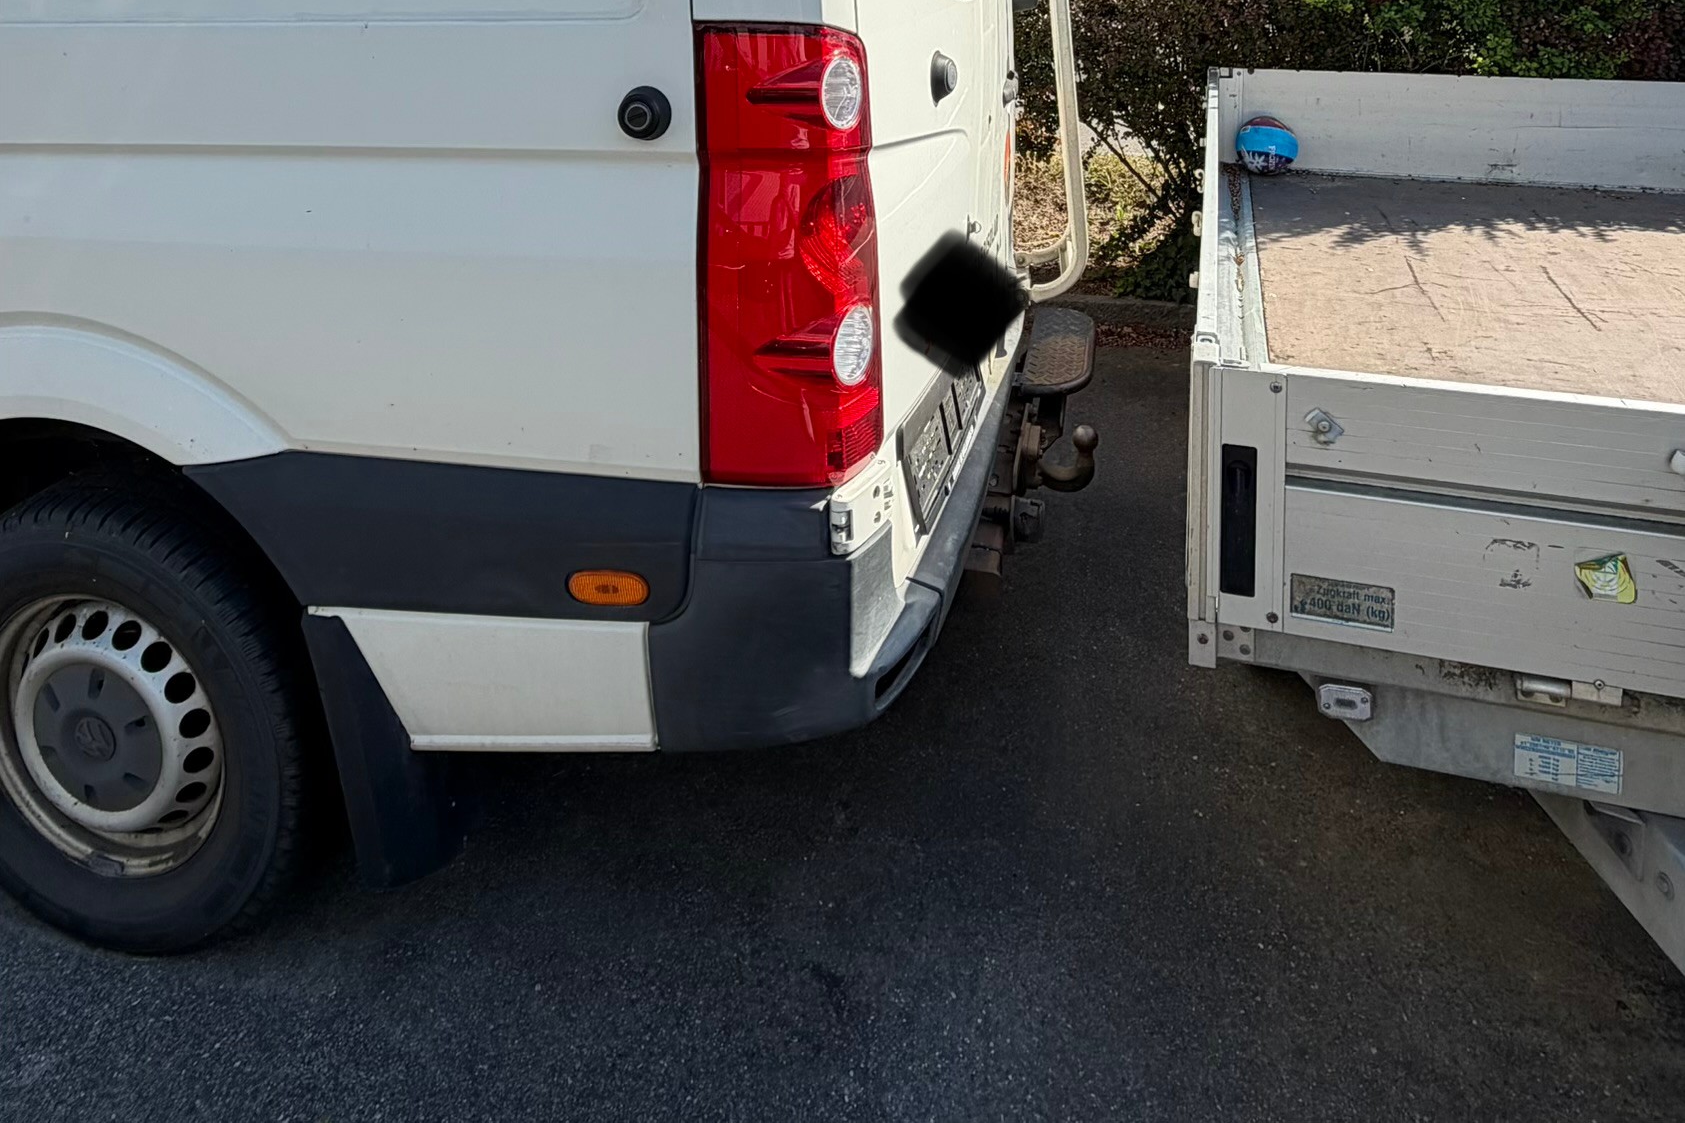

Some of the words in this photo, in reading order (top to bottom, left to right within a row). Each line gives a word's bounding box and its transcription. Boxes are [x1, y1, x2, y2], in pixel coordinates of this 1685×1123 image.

[1316, 585, 1360, 600] Zugkraft
[1363, 594, 1390, 606] max.
[1309, 597, 1332, 611] 400
[1336, 600, 1361, 615] daN
[1366, 606, 1390, 622] (kg)
